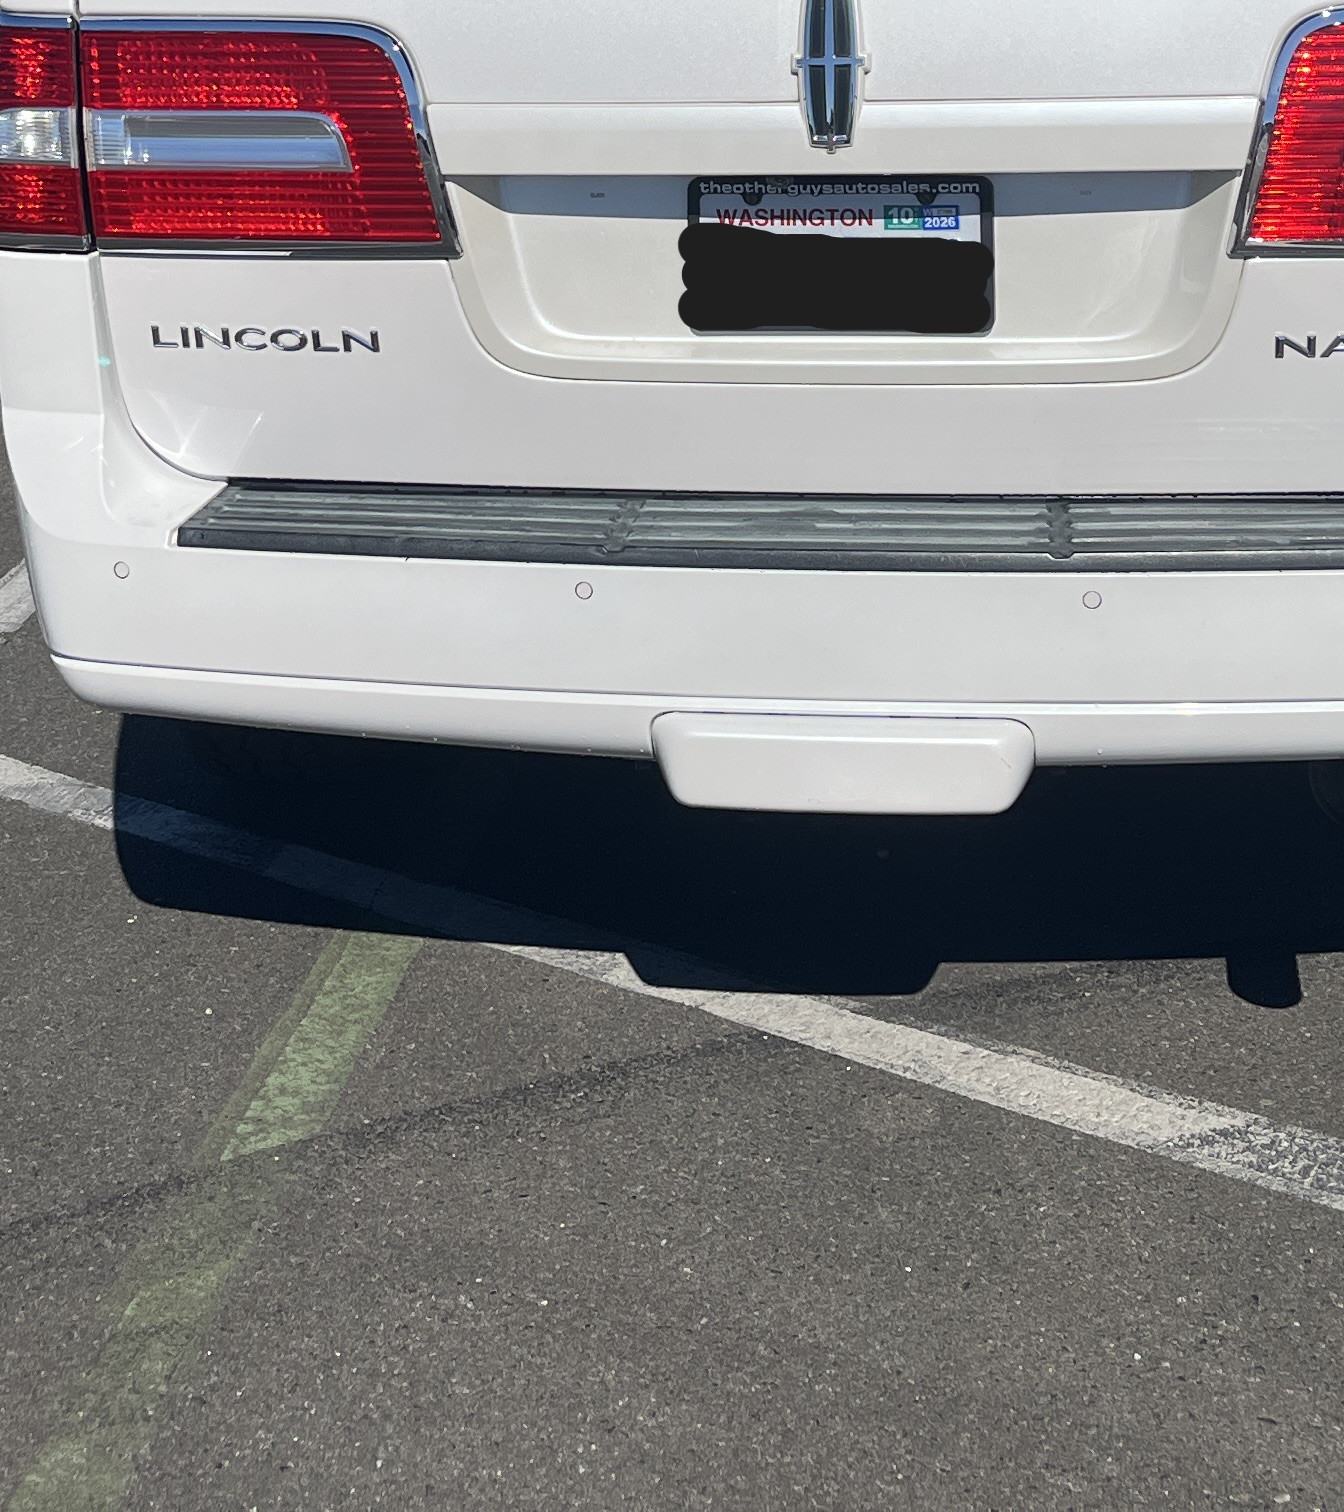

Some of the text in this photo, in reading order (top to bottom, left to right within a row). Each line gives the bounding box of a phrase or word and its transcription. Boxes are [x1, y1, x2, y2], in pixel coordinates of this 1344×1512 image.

[716, 208, 873, 226] WASHINGTON
[887, 207, 914, 224] 10
[924, 216, 956, 228] 2026
[151, 323, 381, 353] LINCOLN
